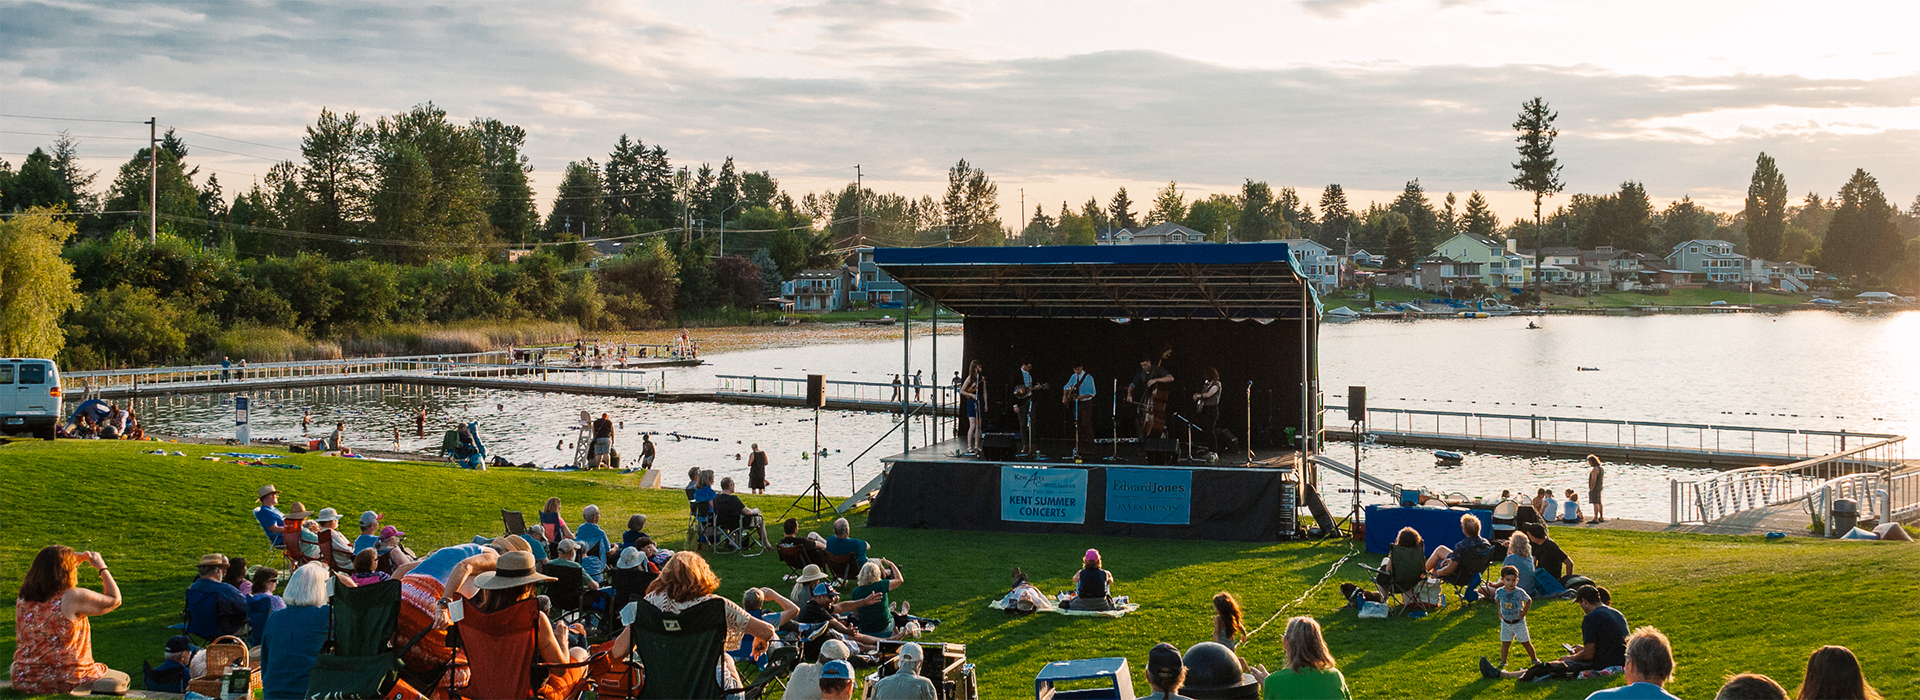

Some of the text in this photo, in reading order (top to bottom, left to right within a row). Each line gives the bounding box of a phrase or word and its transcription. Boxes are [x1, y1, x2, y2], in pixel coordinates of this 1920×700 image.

[1014, 471, 1044, 488] Kent Arts
[1035, 481, 1076, 489] Commission
[1113, 480, 1185, 494] Edward Jones
[1009, 495, 1076, 507] KENT SUMMER
[1019, 507, 1066, 518] CONCERTS
[1118, 503, 1178, 512] INVESTMENTS
